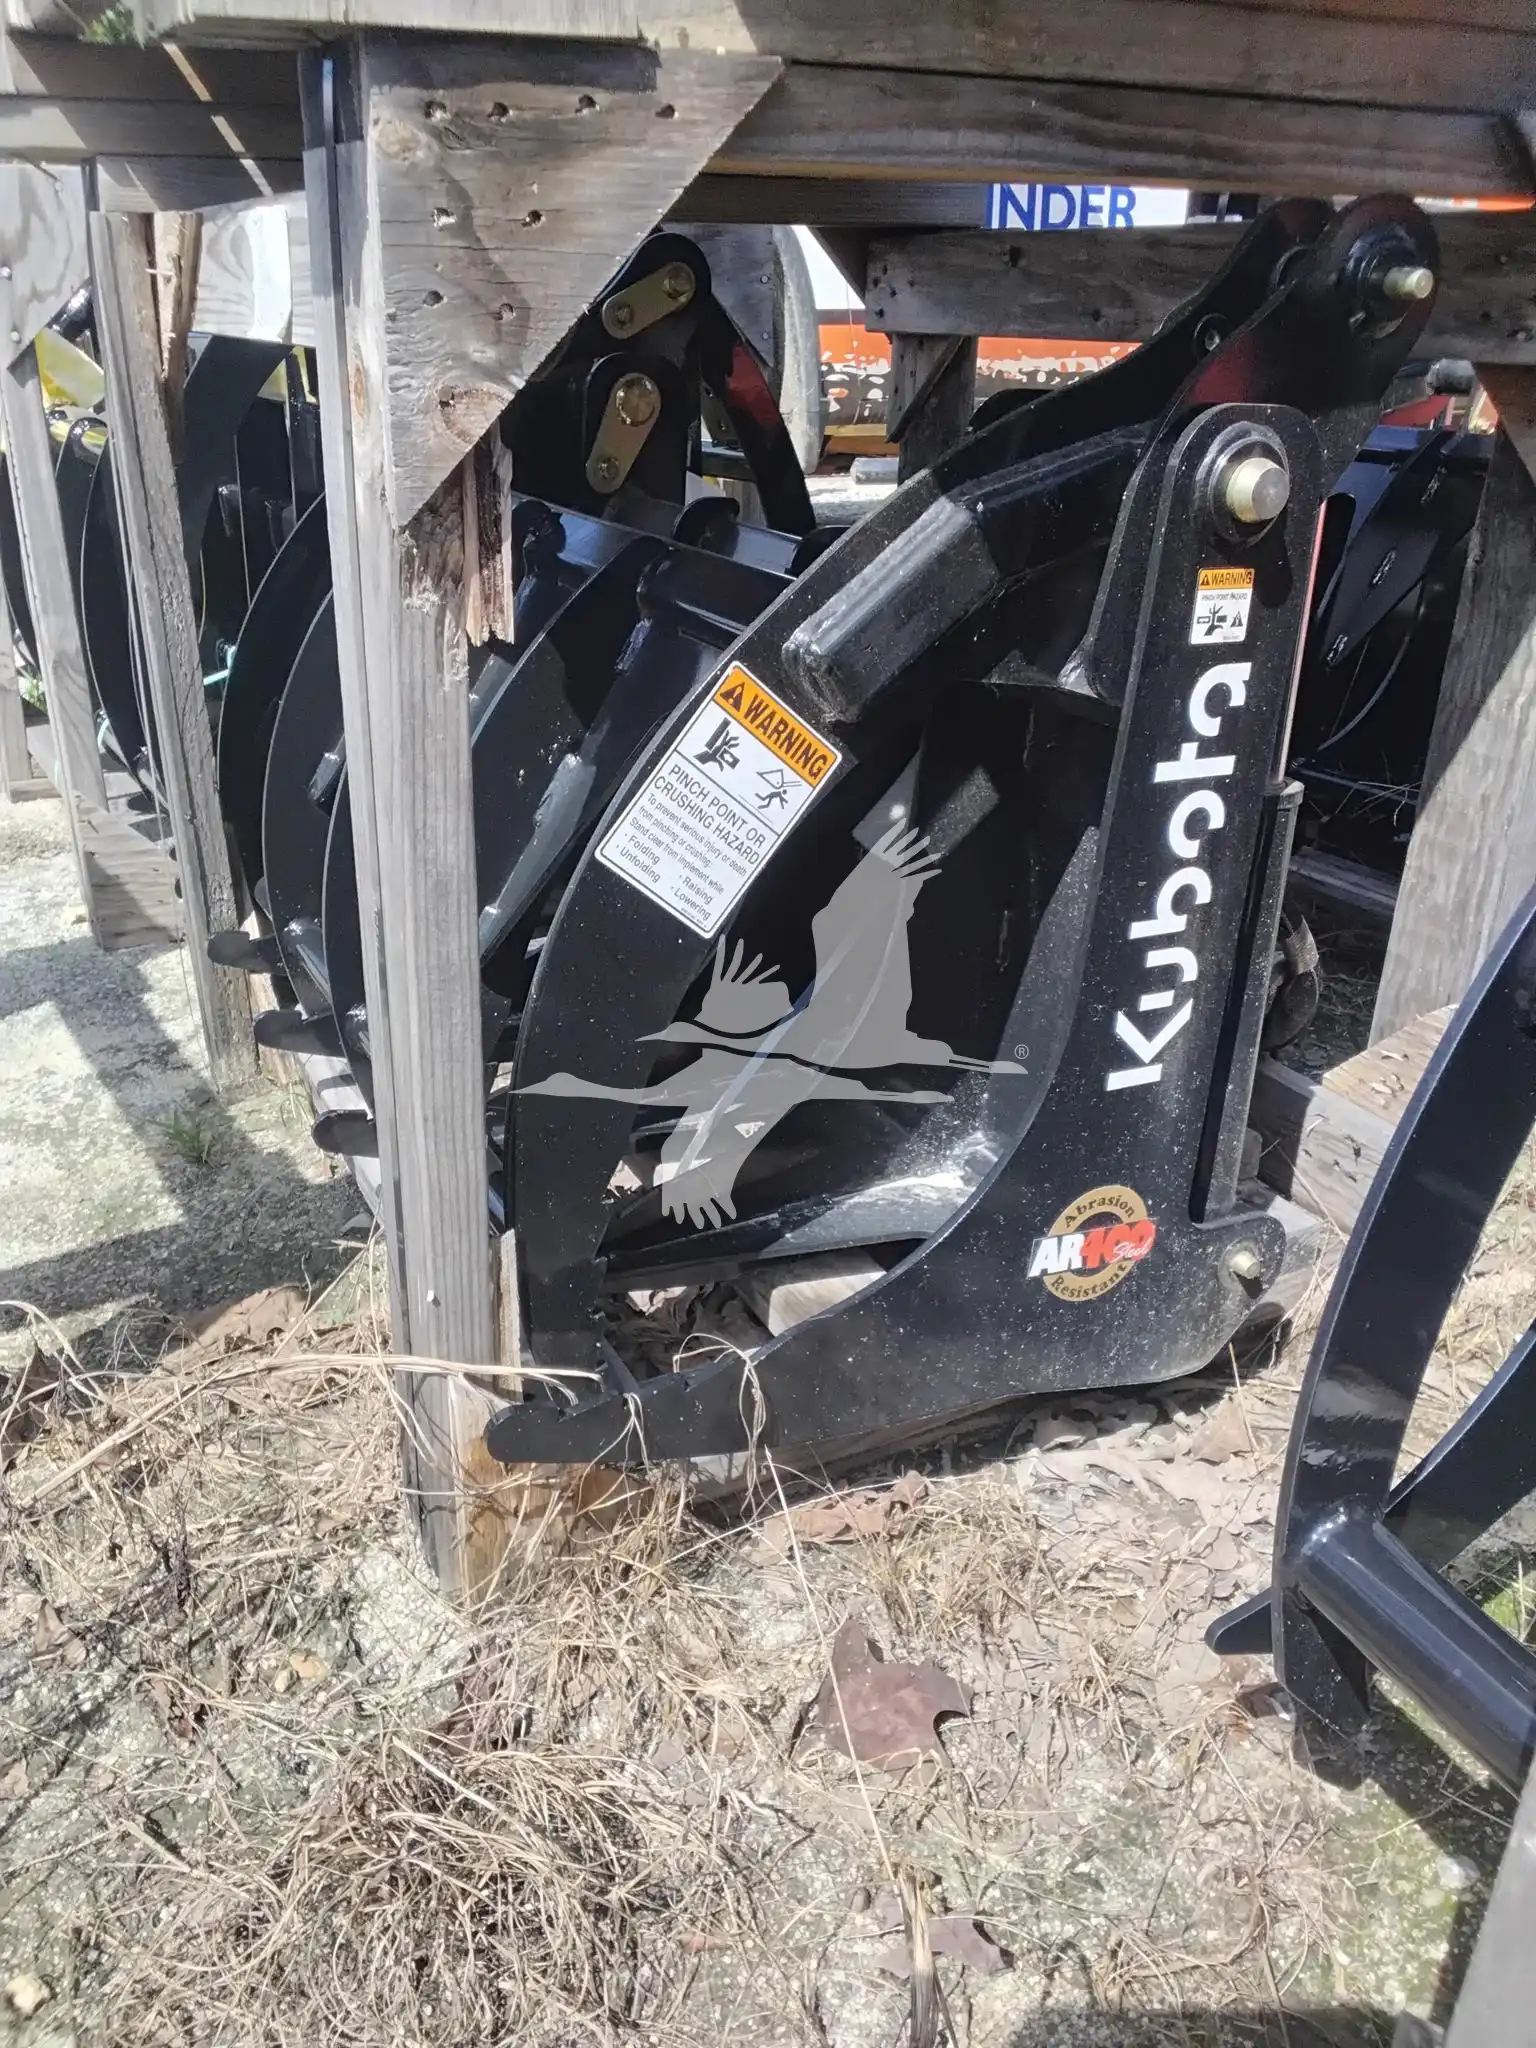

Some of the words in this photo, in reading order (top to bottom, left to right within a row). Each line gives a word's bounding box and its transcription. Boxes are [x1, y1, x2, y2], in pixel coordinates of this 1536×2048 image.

[1211, 571, 1252, 586] WARNING
[739, 693, 831, 780] WARNING
[651, 774, 716, 829] CRUSHING
[711, 822, 761, 865] HAZARD
[667, 763, 710, 802] PINCH
[707, 796, 748, 833] POINT
[744, 826, 766, 848] OR
[637, 805, 654, 821] from
[650, 816, 680, 843] pinching
[677, 837, 686, 847] or
[645, 792, 658, 805] To
[654, 801, 682, 826] prevent
[679, 820, 705, 843] serious
[701, 839, 722, 858] injury
[720, 854, 730, 863] or
[728, 858, 748, 877] death
[617, 846, 662, 883] Unfolding
[626, 834, 662, 865] Folding
[628, 816, 649, 835] Stand
[647, 831, 665, 847] clear
[662, 843, 680, 859] from
[676, 854, 710, 883] implement
[707, 877, 725, 894] while
[680, 876, 714, 905] Raising
[1106, 662, 1252, 1091] Kubota
[672, 887, 712, 921] Lowering
[1065, 1194, 1136, 1229] Abrasion
[1051, 1262, 1128, 1299] Resistant
